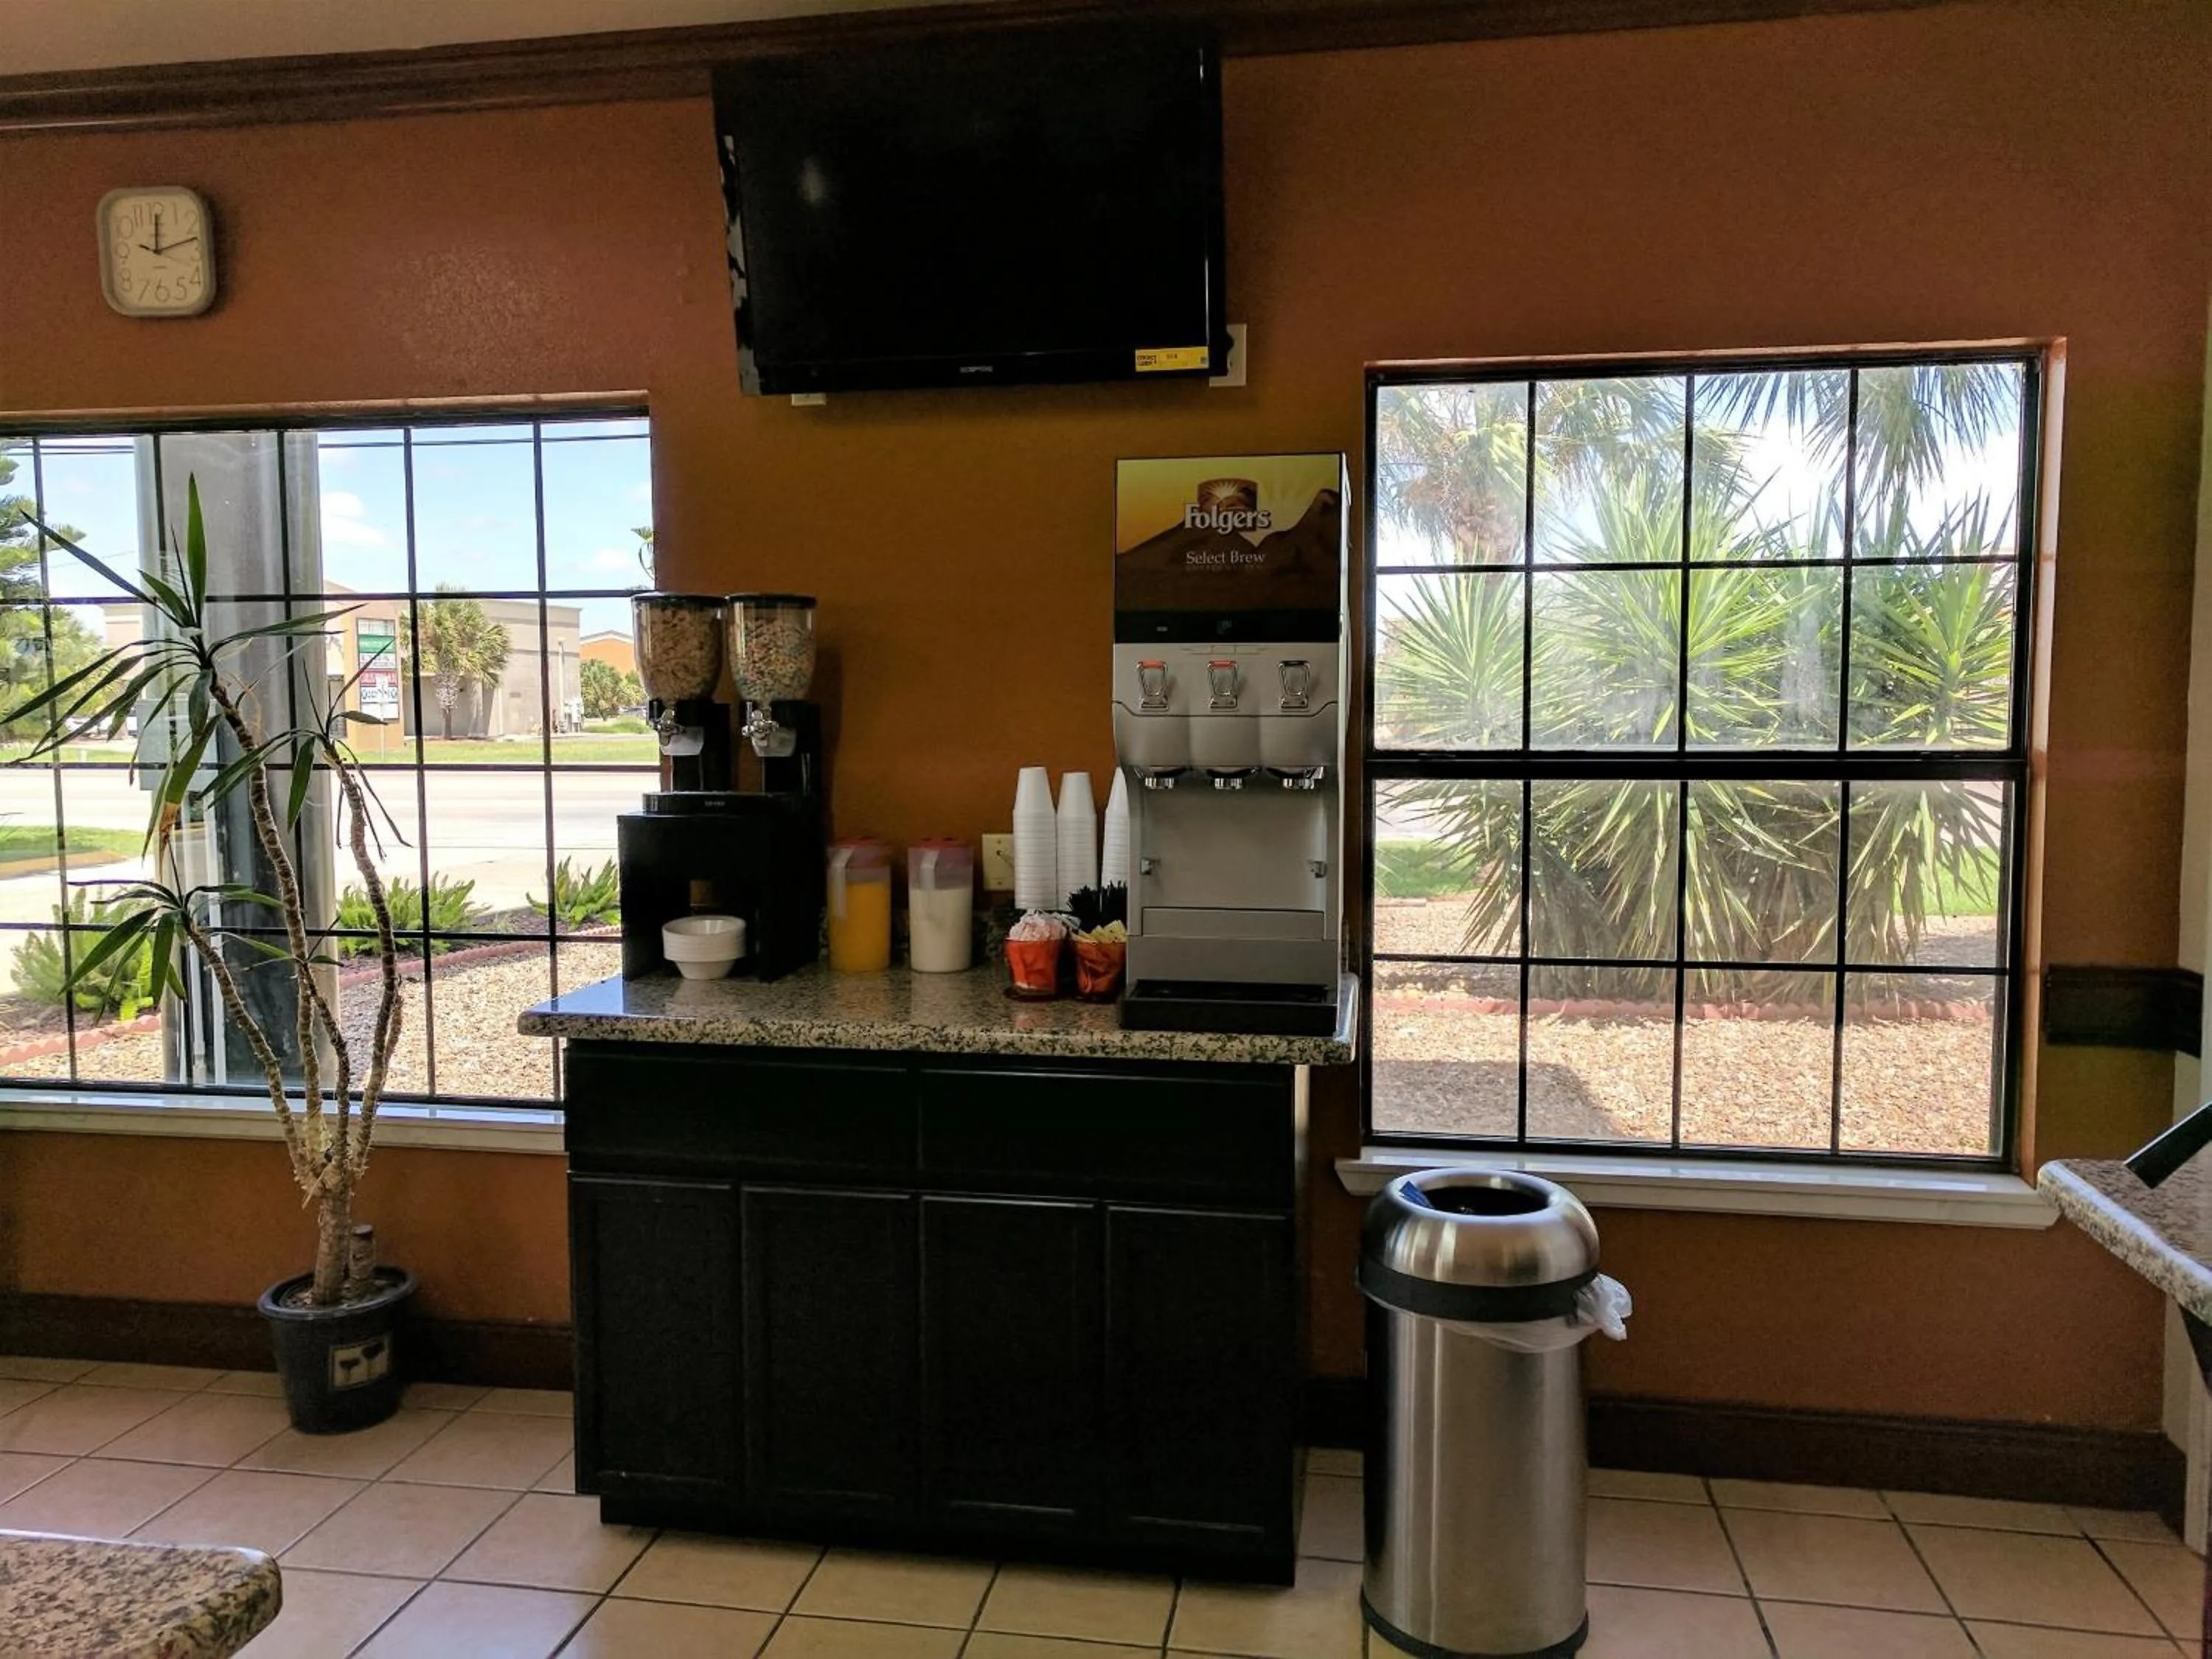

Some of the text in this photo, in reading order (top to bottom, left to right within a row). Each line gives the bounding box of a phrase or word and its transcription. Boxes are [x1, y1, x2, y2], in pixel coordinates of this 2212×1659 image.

[184, 210, 199, 235] 2
[120, 268, 132, 292] 8
[189, 265, 201, 287] 4
[138, 278, 150, 302] 7
[154, 277, 170, 303] 6
[174, 276, 187, 301] 5
[1183, 503, 1271, 535] Folgers
[1186, 551, 1265, 565] Select Brew
